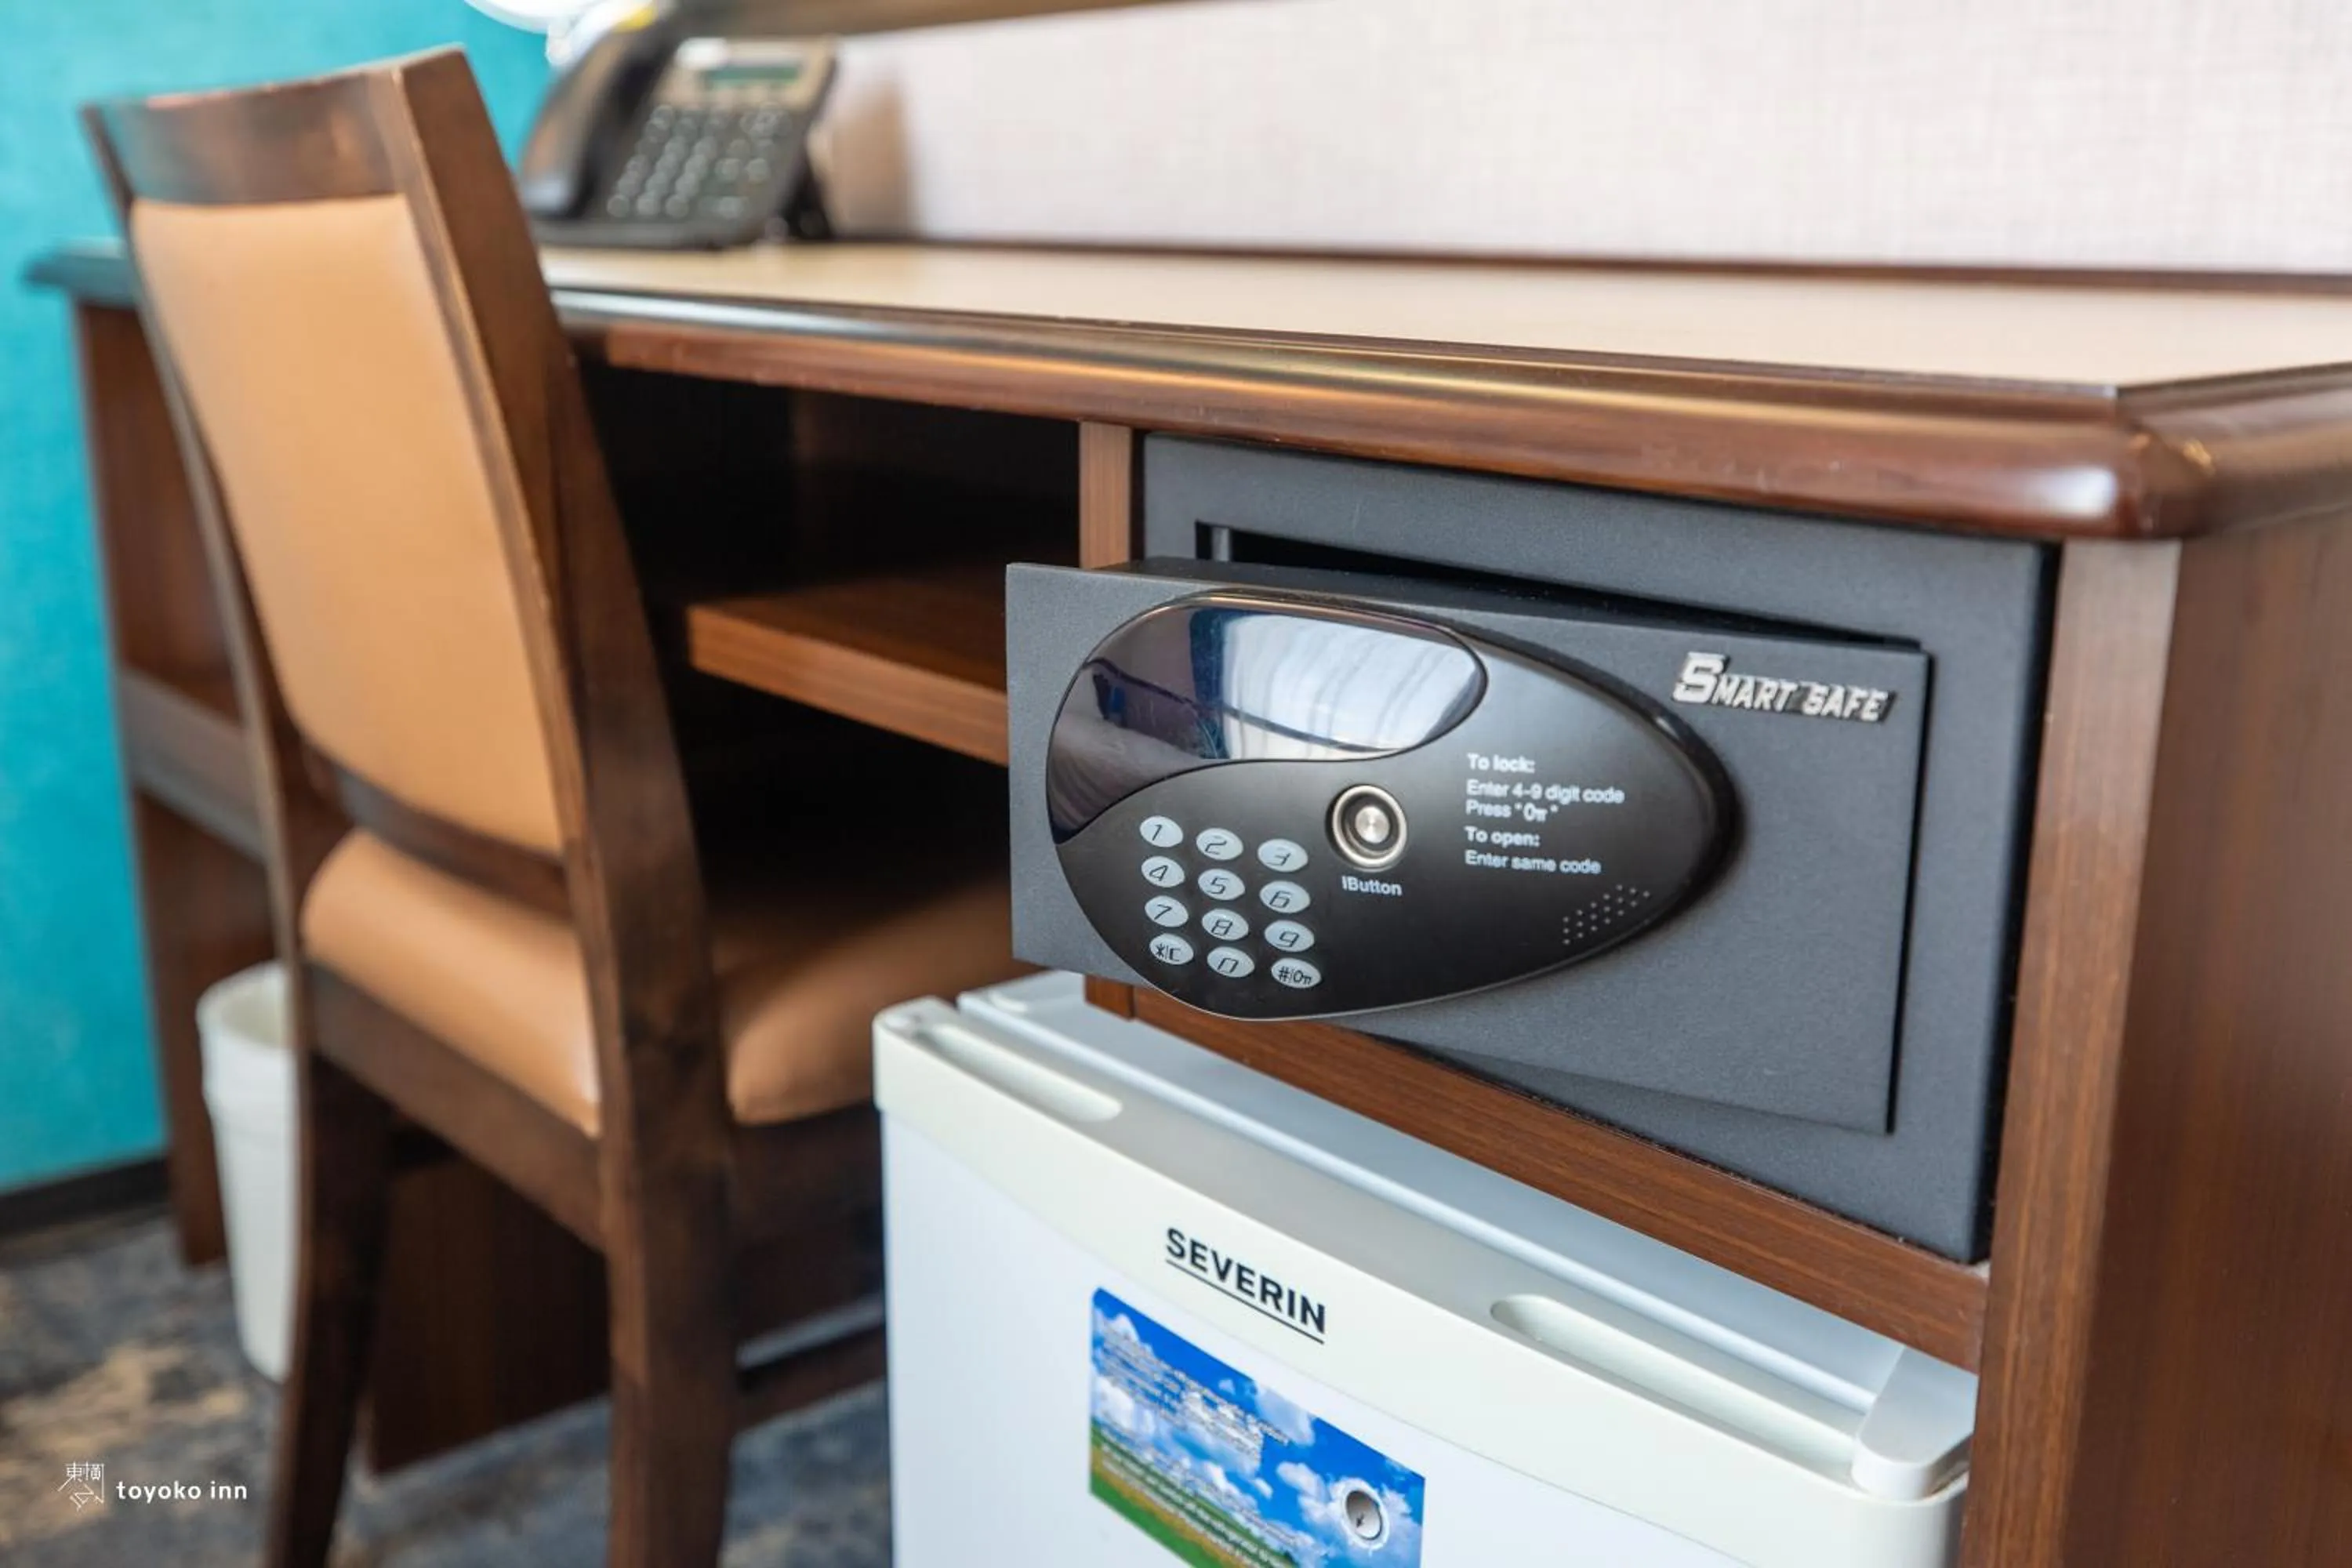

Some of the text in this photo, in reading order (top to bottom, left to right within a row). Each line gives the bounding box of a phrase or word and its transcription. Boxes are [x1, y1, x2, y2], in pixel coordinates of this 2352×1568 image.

[1672, 651, 1889, 722] SMART SAFE
[1467, 753, 1536, 774] To lock:
[1466, 779, 1625, 805] Enter 4-9 digit code
[1465, 799, 1512, 818] Press
[1205, 836, 1228, 855] 2
[1465, 826, 1541, 848] To open:
[1465, 850, 1602, 874] Enter same code
[1149, 865, 1169, 882] 4
[1208, 877, 1229, 895] 5
[1269, 891, 1293, 909] 6
[1154, 904, 1172, 920] 7
[1211, 920, 1233, 936] 8
[1276, 931, 1301, 947] 9
[1166, 1228, 1326, 1334] SEVERIN
